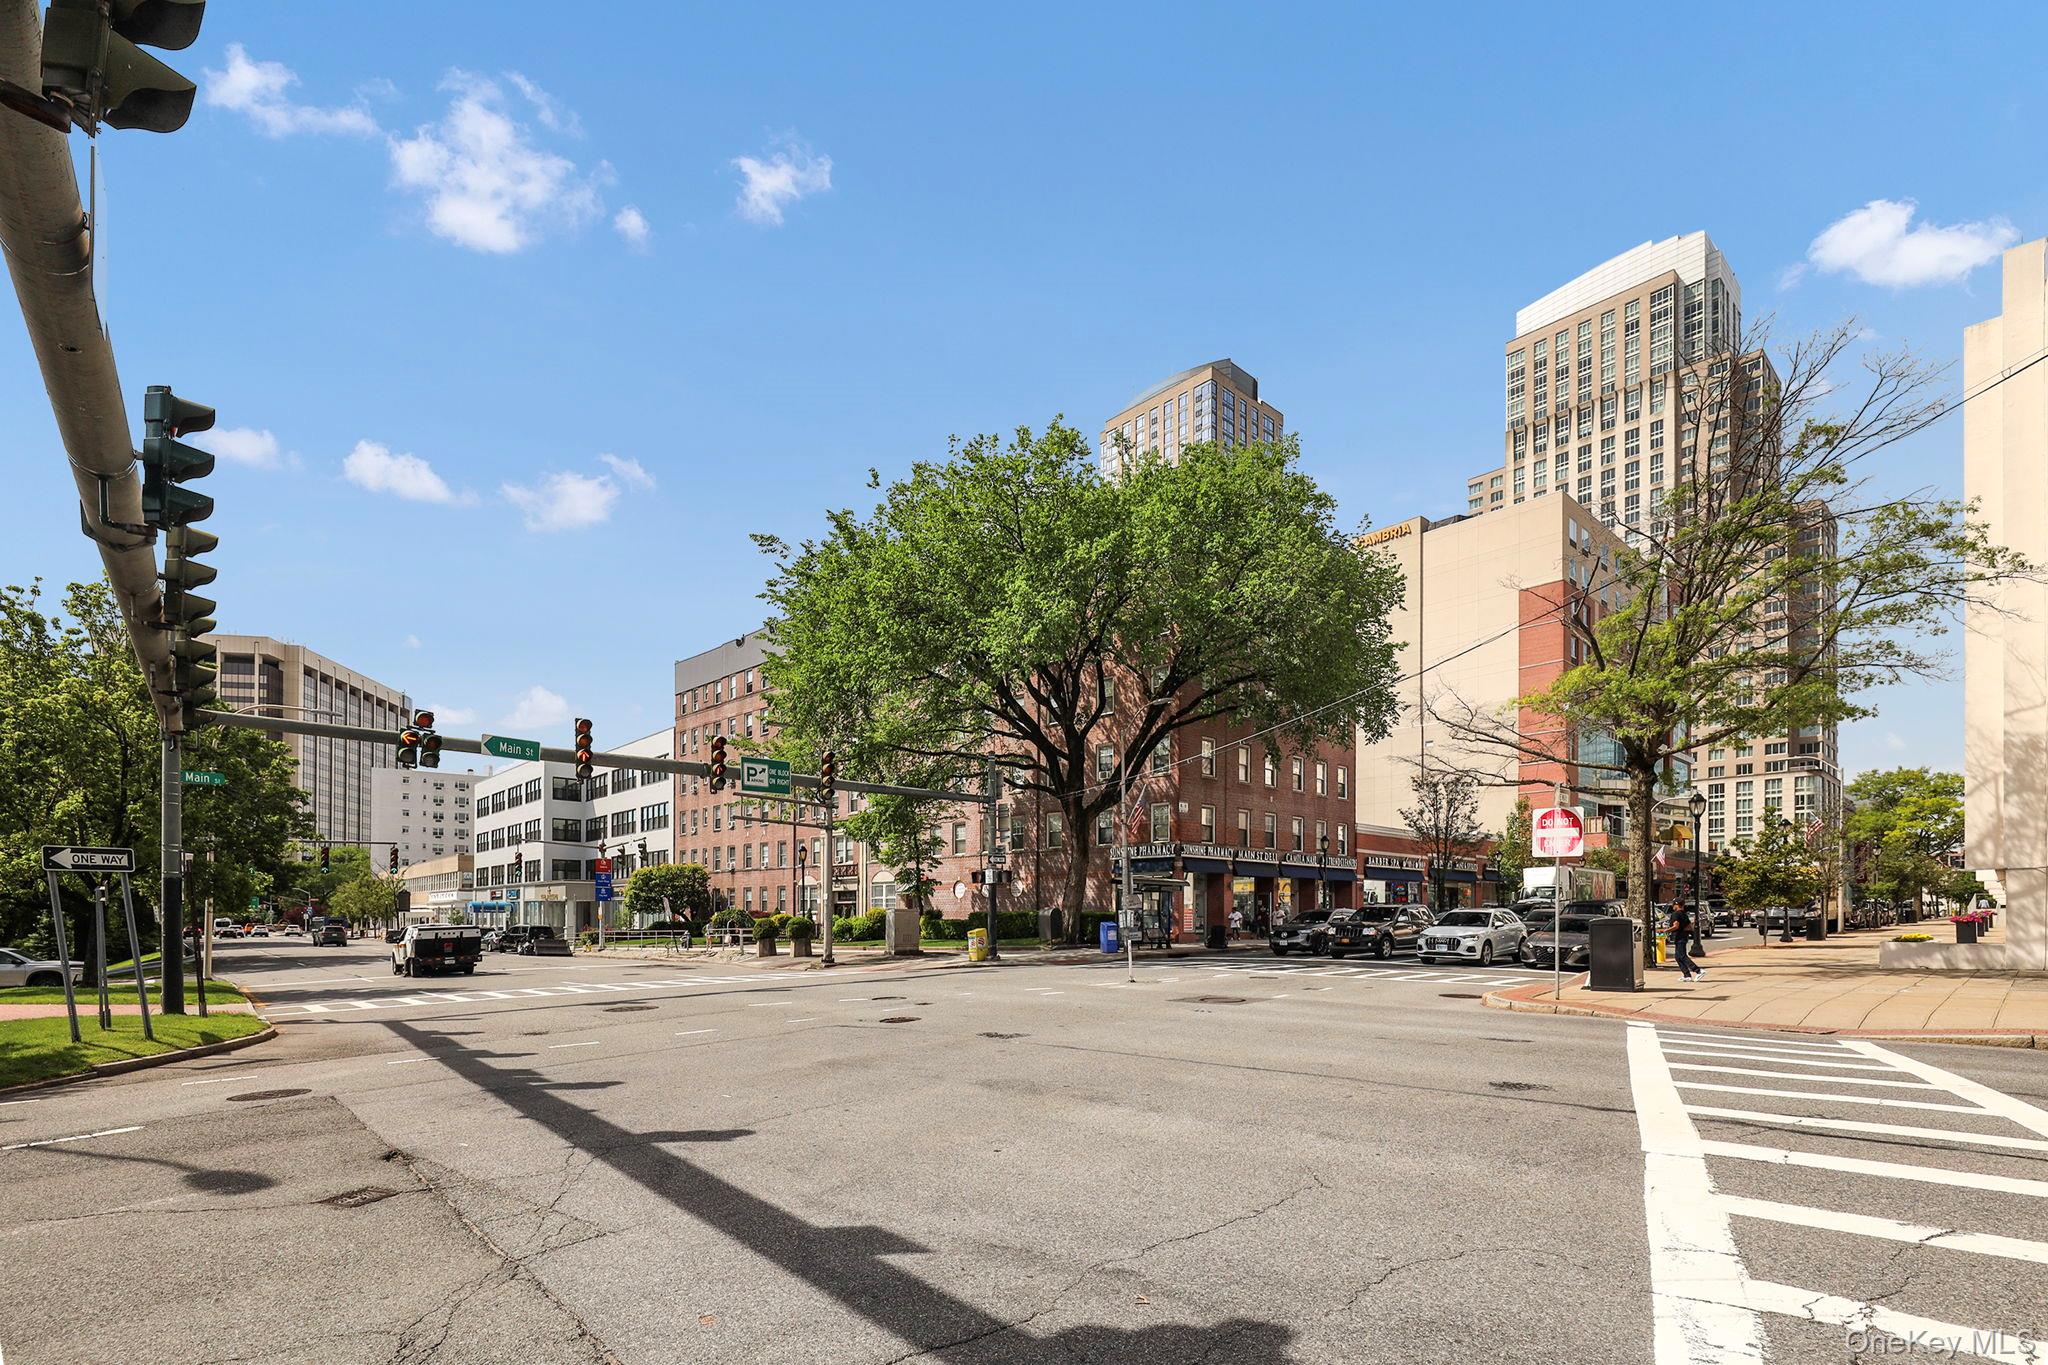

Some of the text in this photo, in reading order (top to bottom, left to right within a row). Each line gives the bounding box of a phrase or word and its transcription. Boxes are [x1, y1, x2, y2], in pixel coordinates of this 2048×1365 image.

[499, 742, 534, 756] Main St
[185, 772, 210, 783] Main
[1542, 818, 1553, 826] DO
[1109, 843, 1176, 858] SUNSNE PHARMACY
[1182, 844, 1234, 858] SUNSHINE PHARMACY
[1238, 849, 1255, 860] MAIN
[72, 854, 124, 865] ONE WAY
[1368, 856, 1390, 866] BARBER
